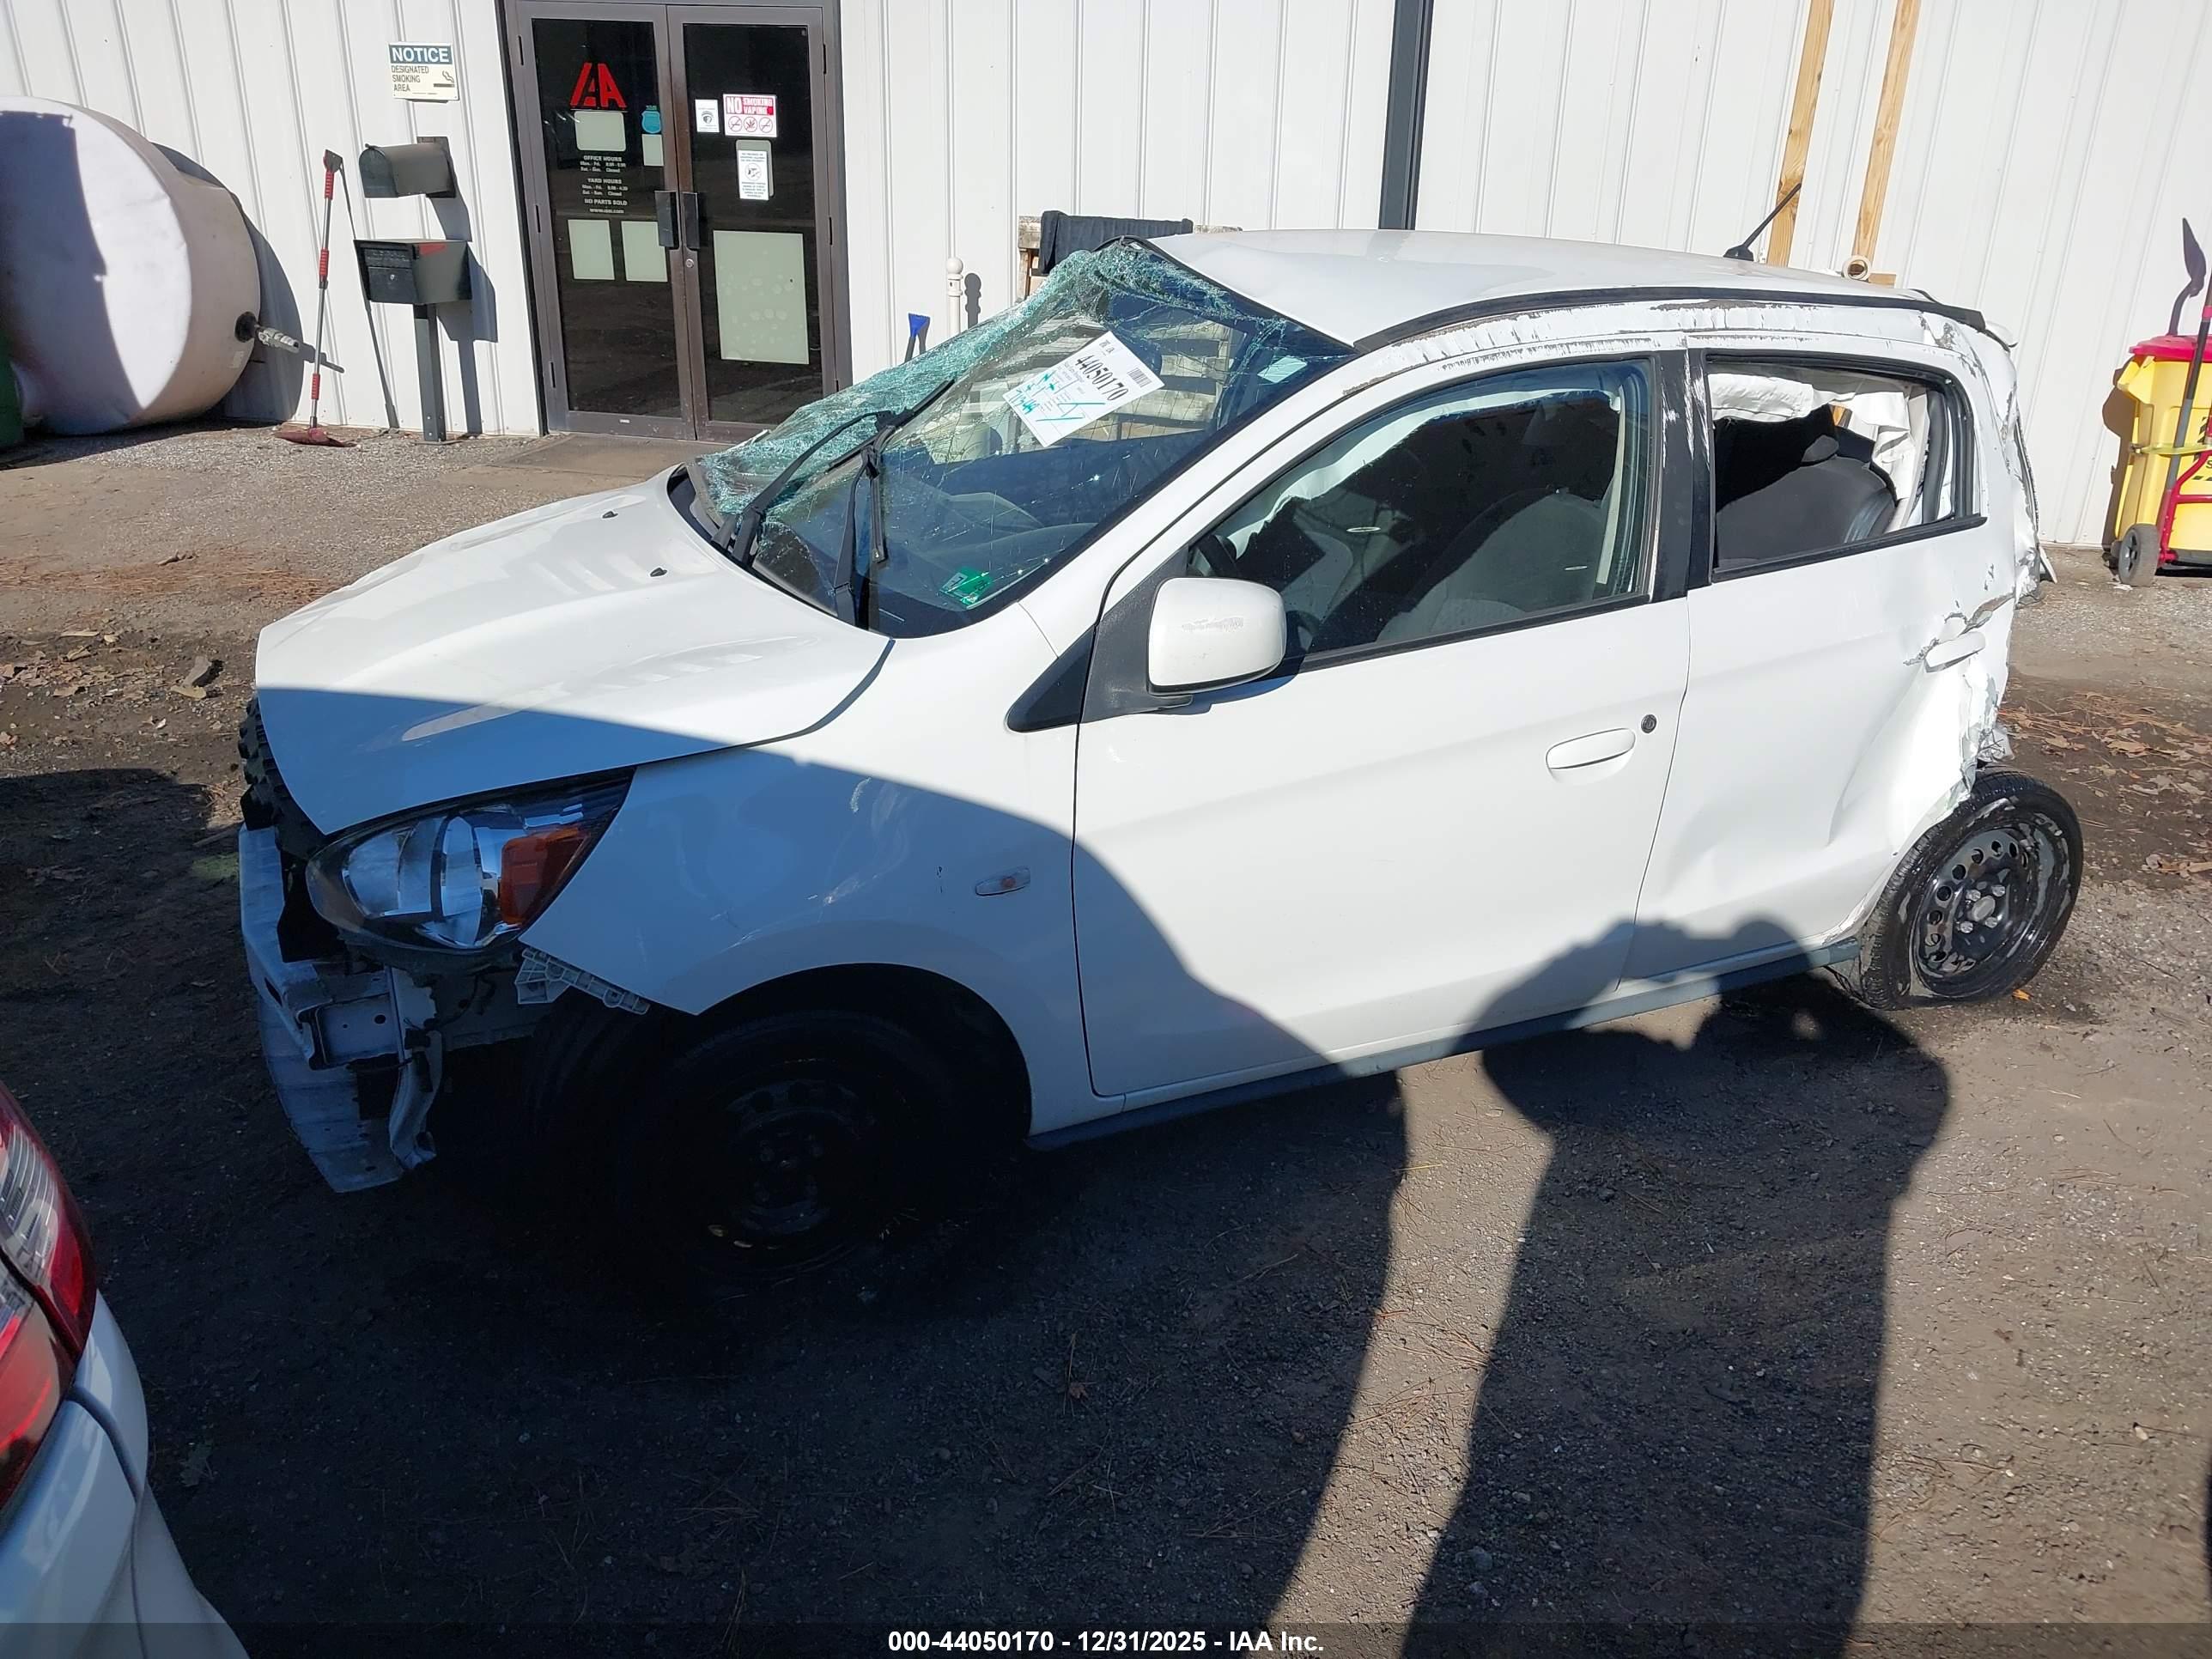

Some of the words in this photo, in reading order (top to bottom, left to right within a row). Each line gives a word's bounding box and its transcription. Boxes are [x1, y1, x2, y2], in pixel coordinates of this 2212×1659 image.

[392, 47, 450, 63] NOTICE
[391, 65, 429, 74] DESIGNATED
[392, 75, 421, 83] SMOKING
[393, 83, 410, 92] AREA
[726, 96, 743, 114] NO
[1075, 355, 1129, 401] 44050170
